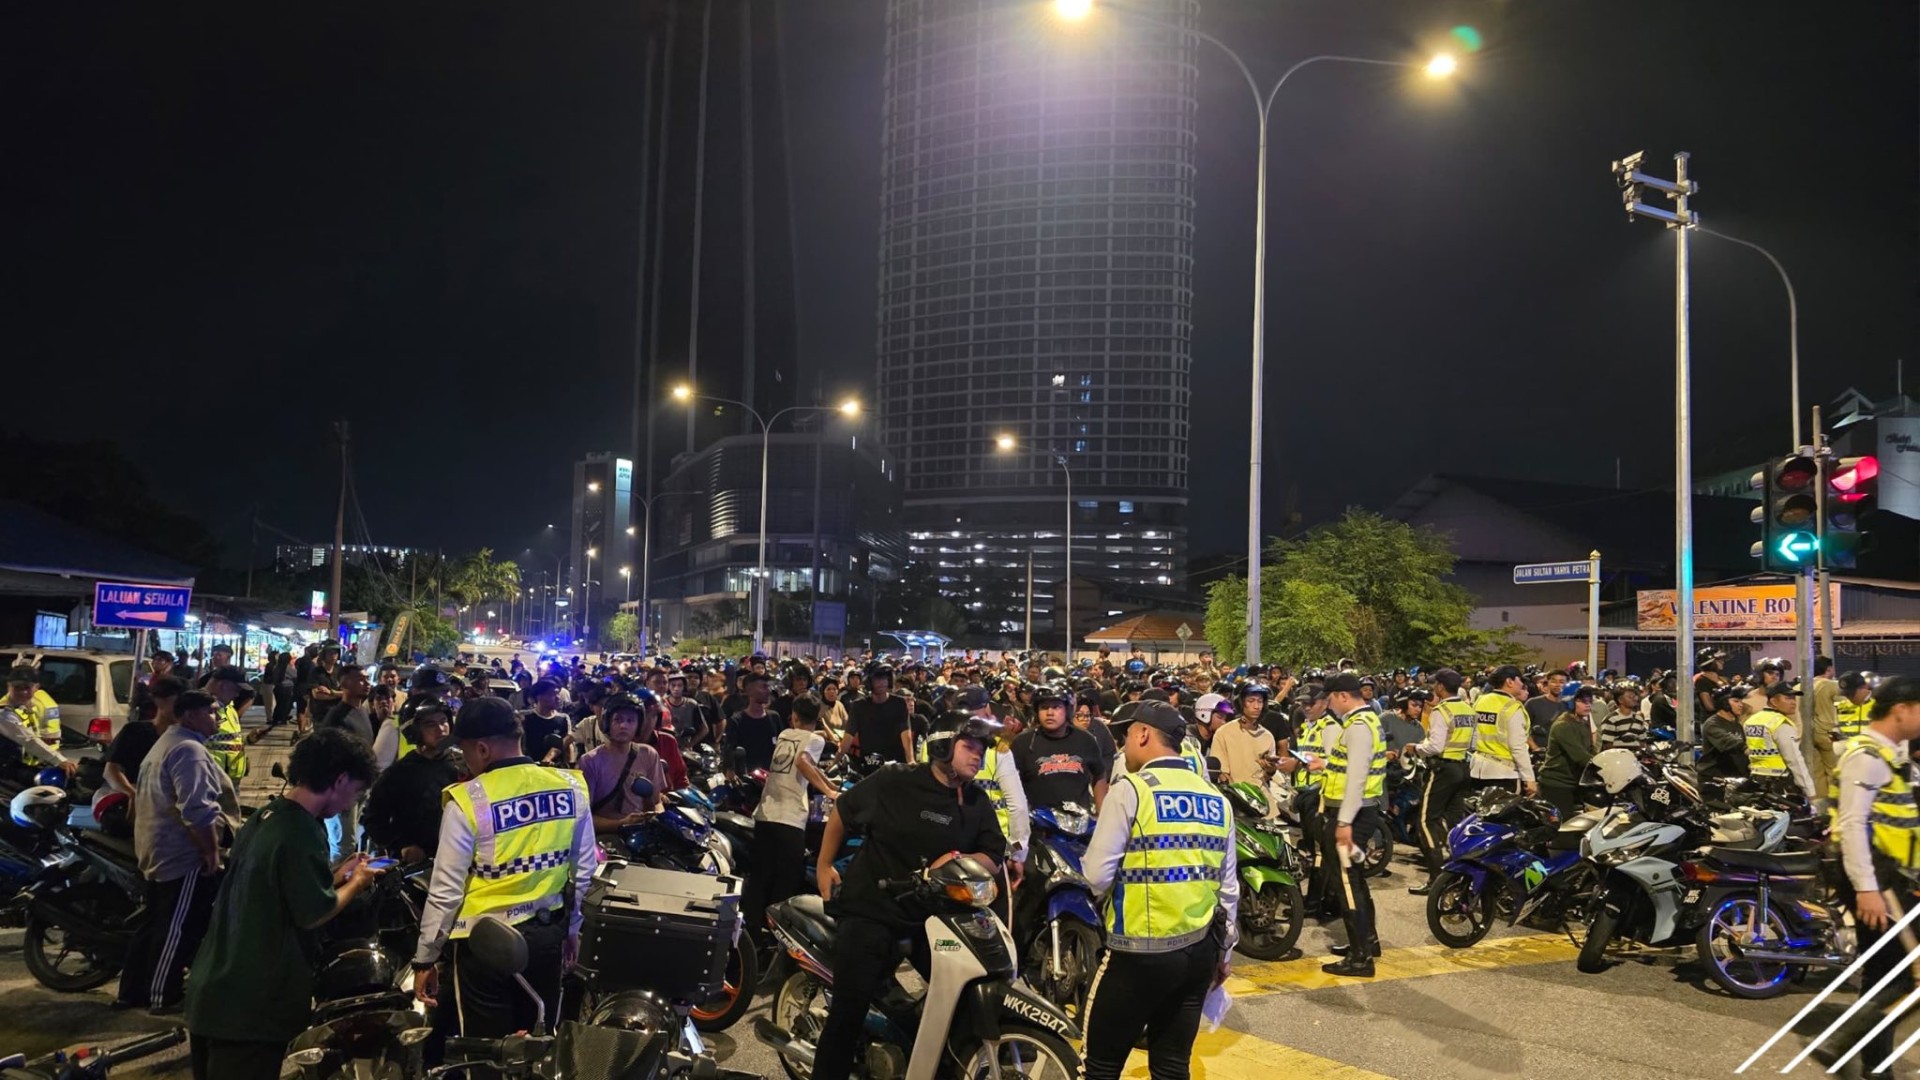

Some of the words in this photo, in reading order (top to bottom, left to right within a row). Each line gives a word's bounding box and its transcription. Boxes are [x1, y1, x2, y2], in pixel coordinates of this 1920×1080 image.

[1515, 568, 1532, 578] JALAN
[1533, 567, 1552, 577] SULTAN
[1572, 564, 1591, 575] PETRA
[100, 589, 141, 605] LALUAN
[143, 592, 185, 607] SEHALA
[1669, 598, 1758, 615] VLENTINE
[498, 792, 570, 828] POLIS
[1159, 795, 1221, 821] POLIS
[506, 902, 534, 919] PDRM
[1003, 993, 1069, 1034] WKK2947
